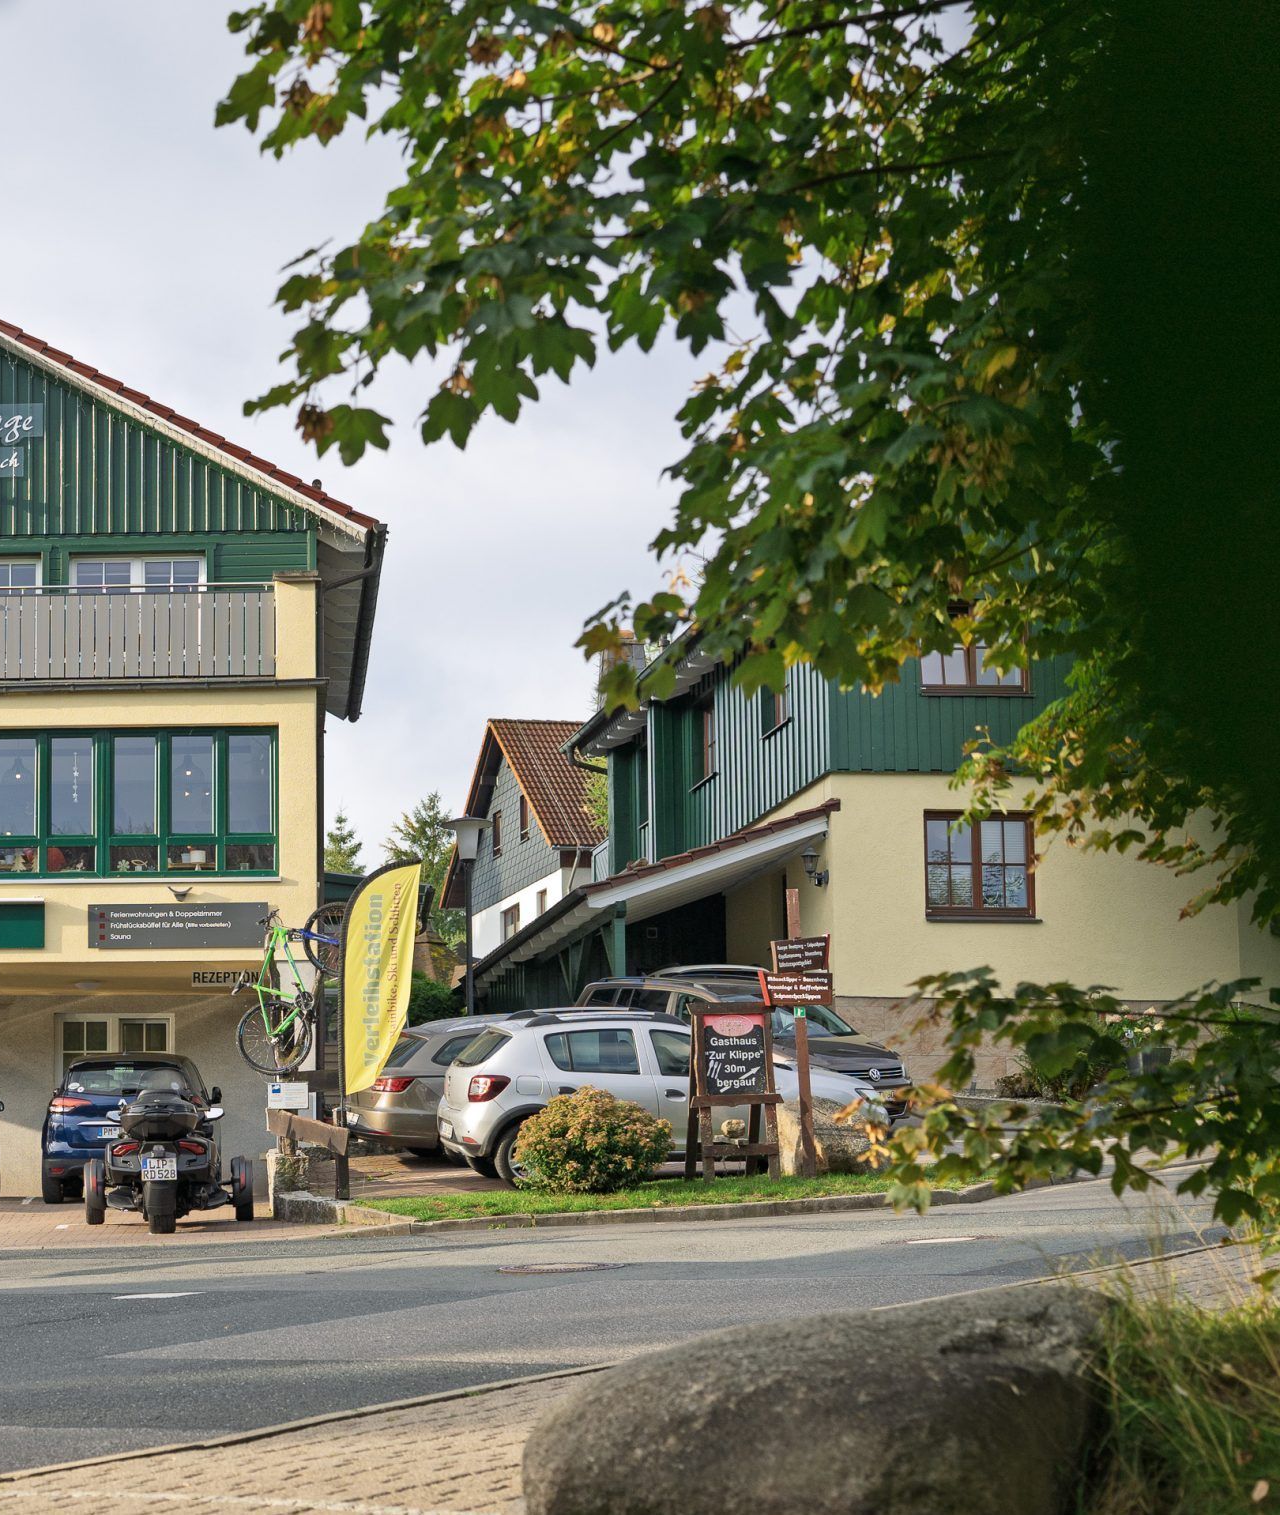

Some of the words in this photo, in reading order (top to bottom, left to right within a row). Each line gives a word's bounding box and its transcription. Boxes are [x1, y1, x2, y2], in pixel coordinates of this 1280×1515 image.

[175, 910, 223, 918] Doppelzimmer
[363, 893, 384, 1068] Verleihstation
[710, 1037, 757, 1046] Gasthaus
[705, 1050, 726, 1060] "Zur
[729, 1050, 764, 1061] Klippe"
[724, 1064, 746, 1073] 30m
[716, 1077, 756, 1088] bergauf
[148, 1159, 168, 1169] LIP
[142, 1170, 156, 1180] RD
[157, 1170, 176, 1179] 528
